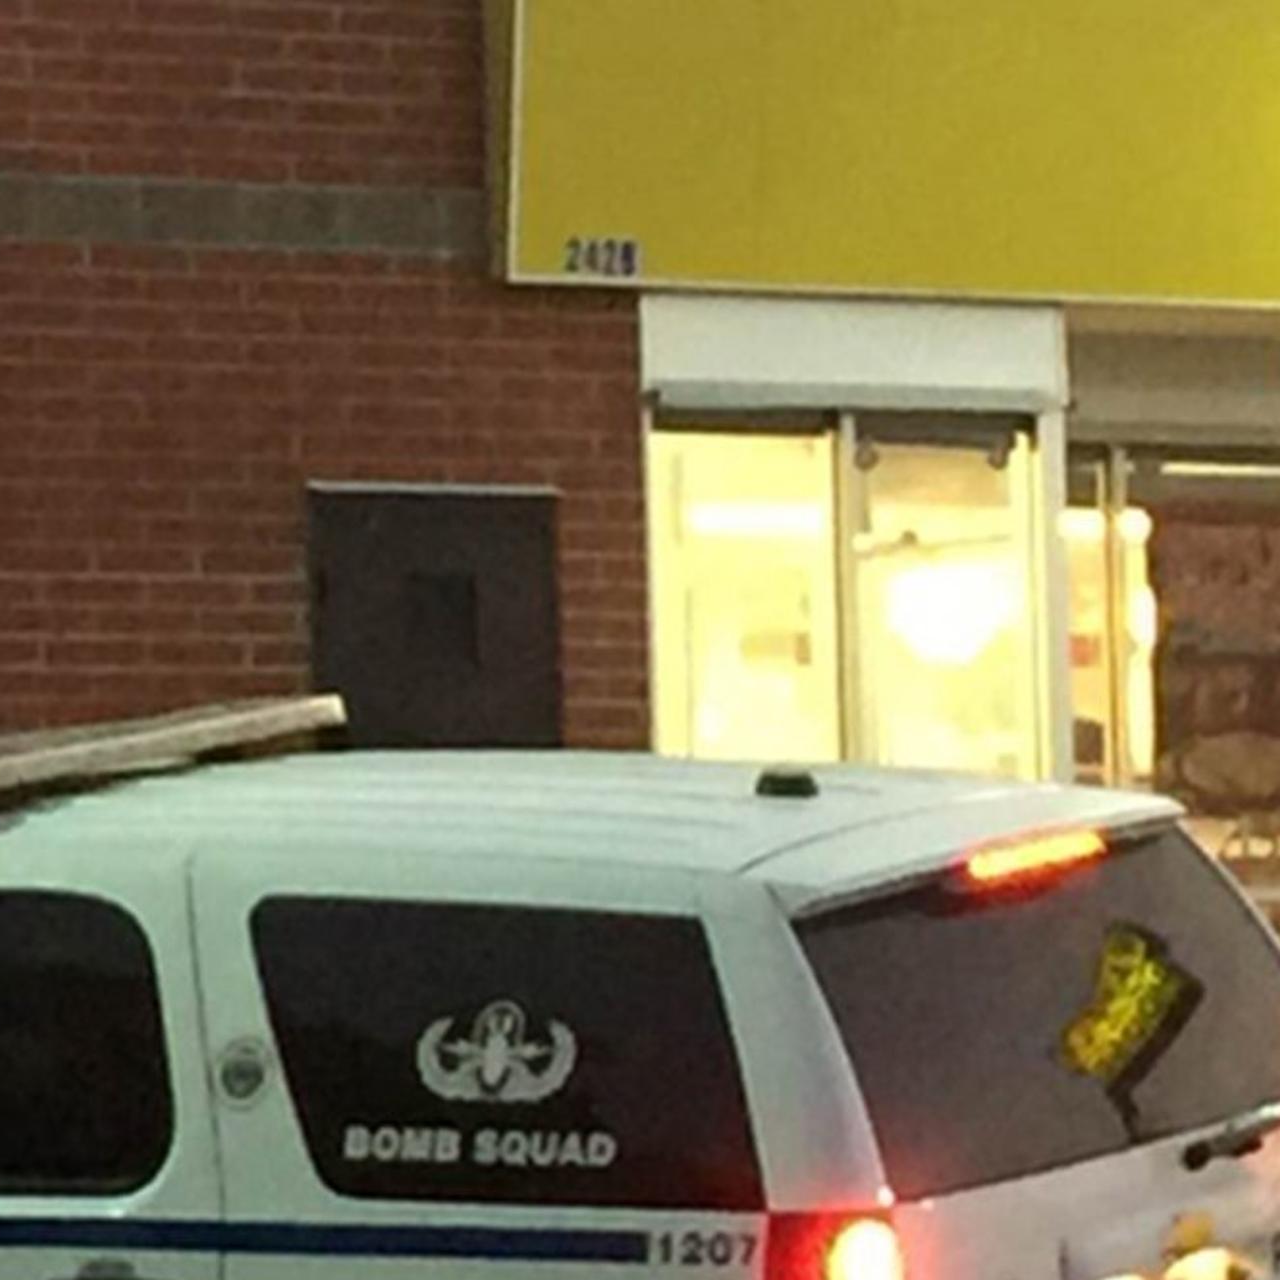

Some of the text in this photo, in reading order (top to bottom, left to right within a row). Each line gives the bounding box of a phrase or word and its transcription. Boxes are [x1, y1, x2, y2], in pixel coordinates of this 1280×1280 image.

[344, 1126, 618, 1168] BOMB SQUAD
[656, 1231, 758, 1266] 1207
